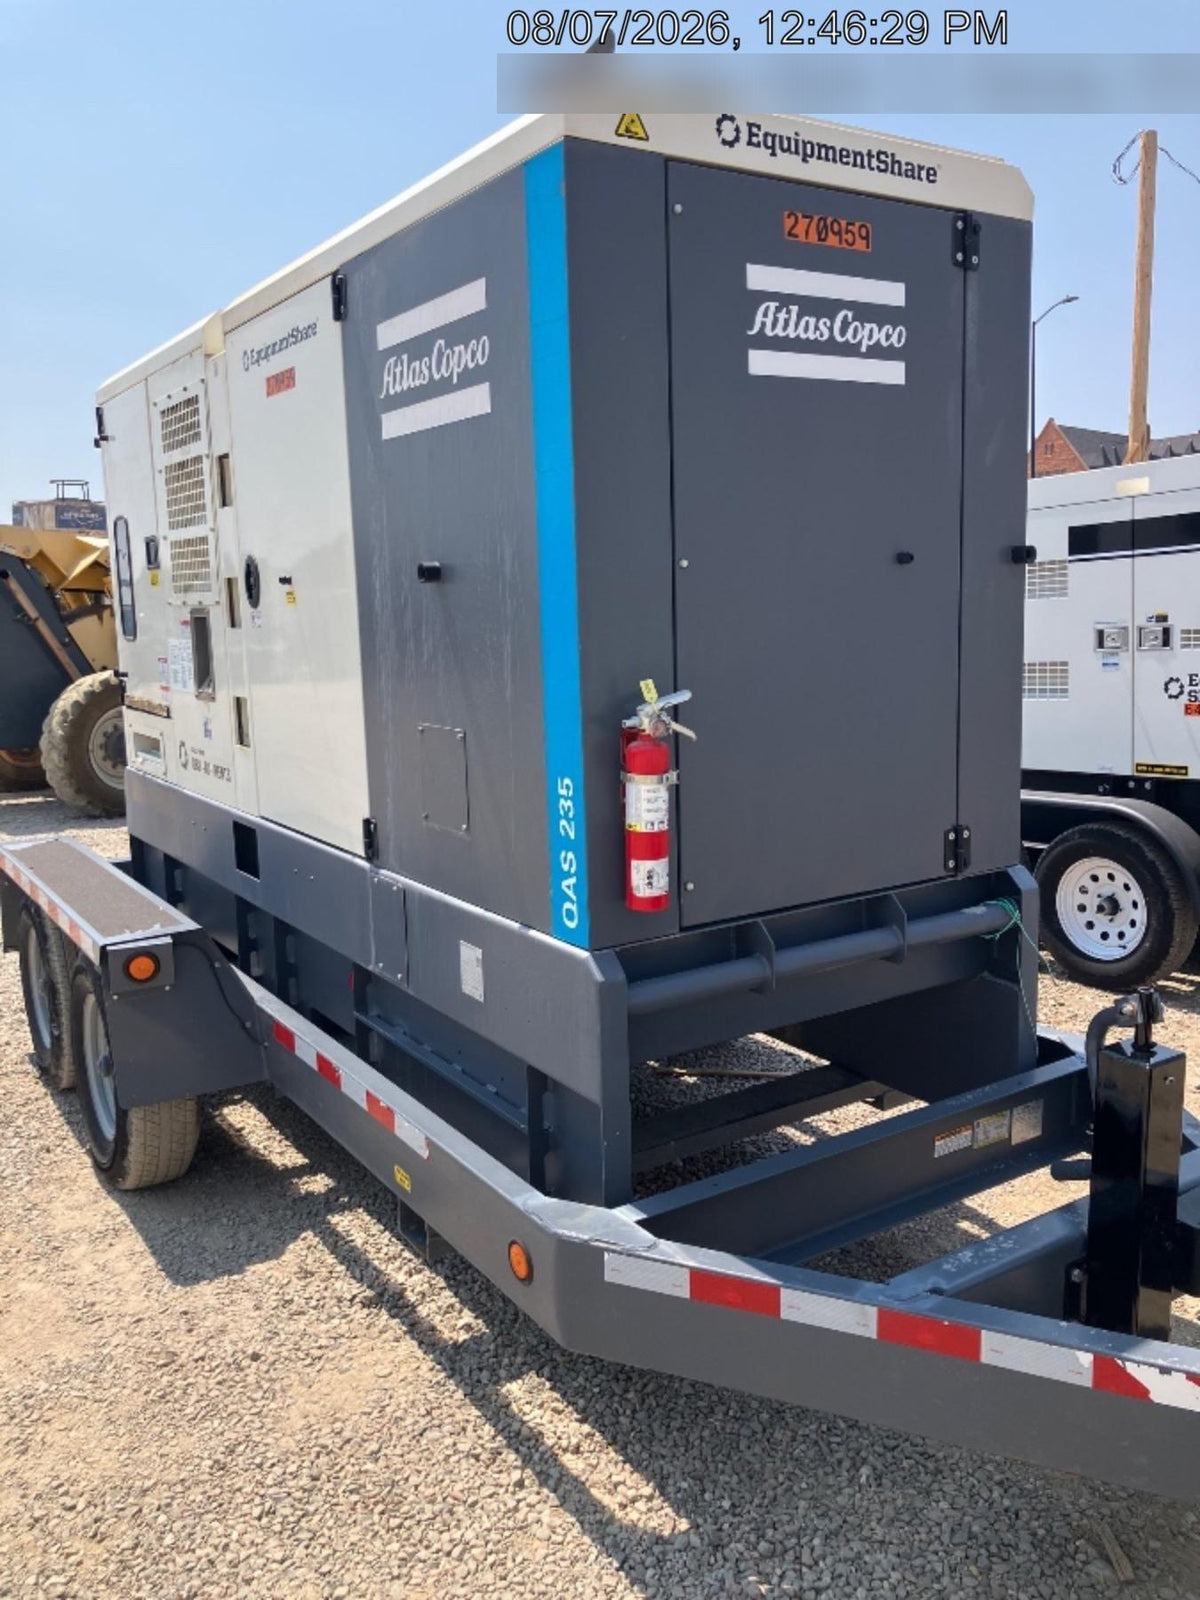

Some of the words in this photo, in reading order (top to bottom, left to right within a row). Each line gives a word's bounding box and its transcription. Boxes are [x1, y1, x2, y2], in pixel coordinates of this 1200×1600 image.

[746, 121, 938, 184] EquipmentShare
[785, 212, 871, 250] 270959
[747, 301, 831, 342] Atlas
[833, 309, 907, 353] Copco
[380, 353, 430, 399] Atlas
[431, 335, 490, 385] Copco
[1187, 690, 1200, 703] S
[1188, 673, 1200, 687] E
[557, 776, 576, 840] 235
[560, 850, 579, 929] QAS
